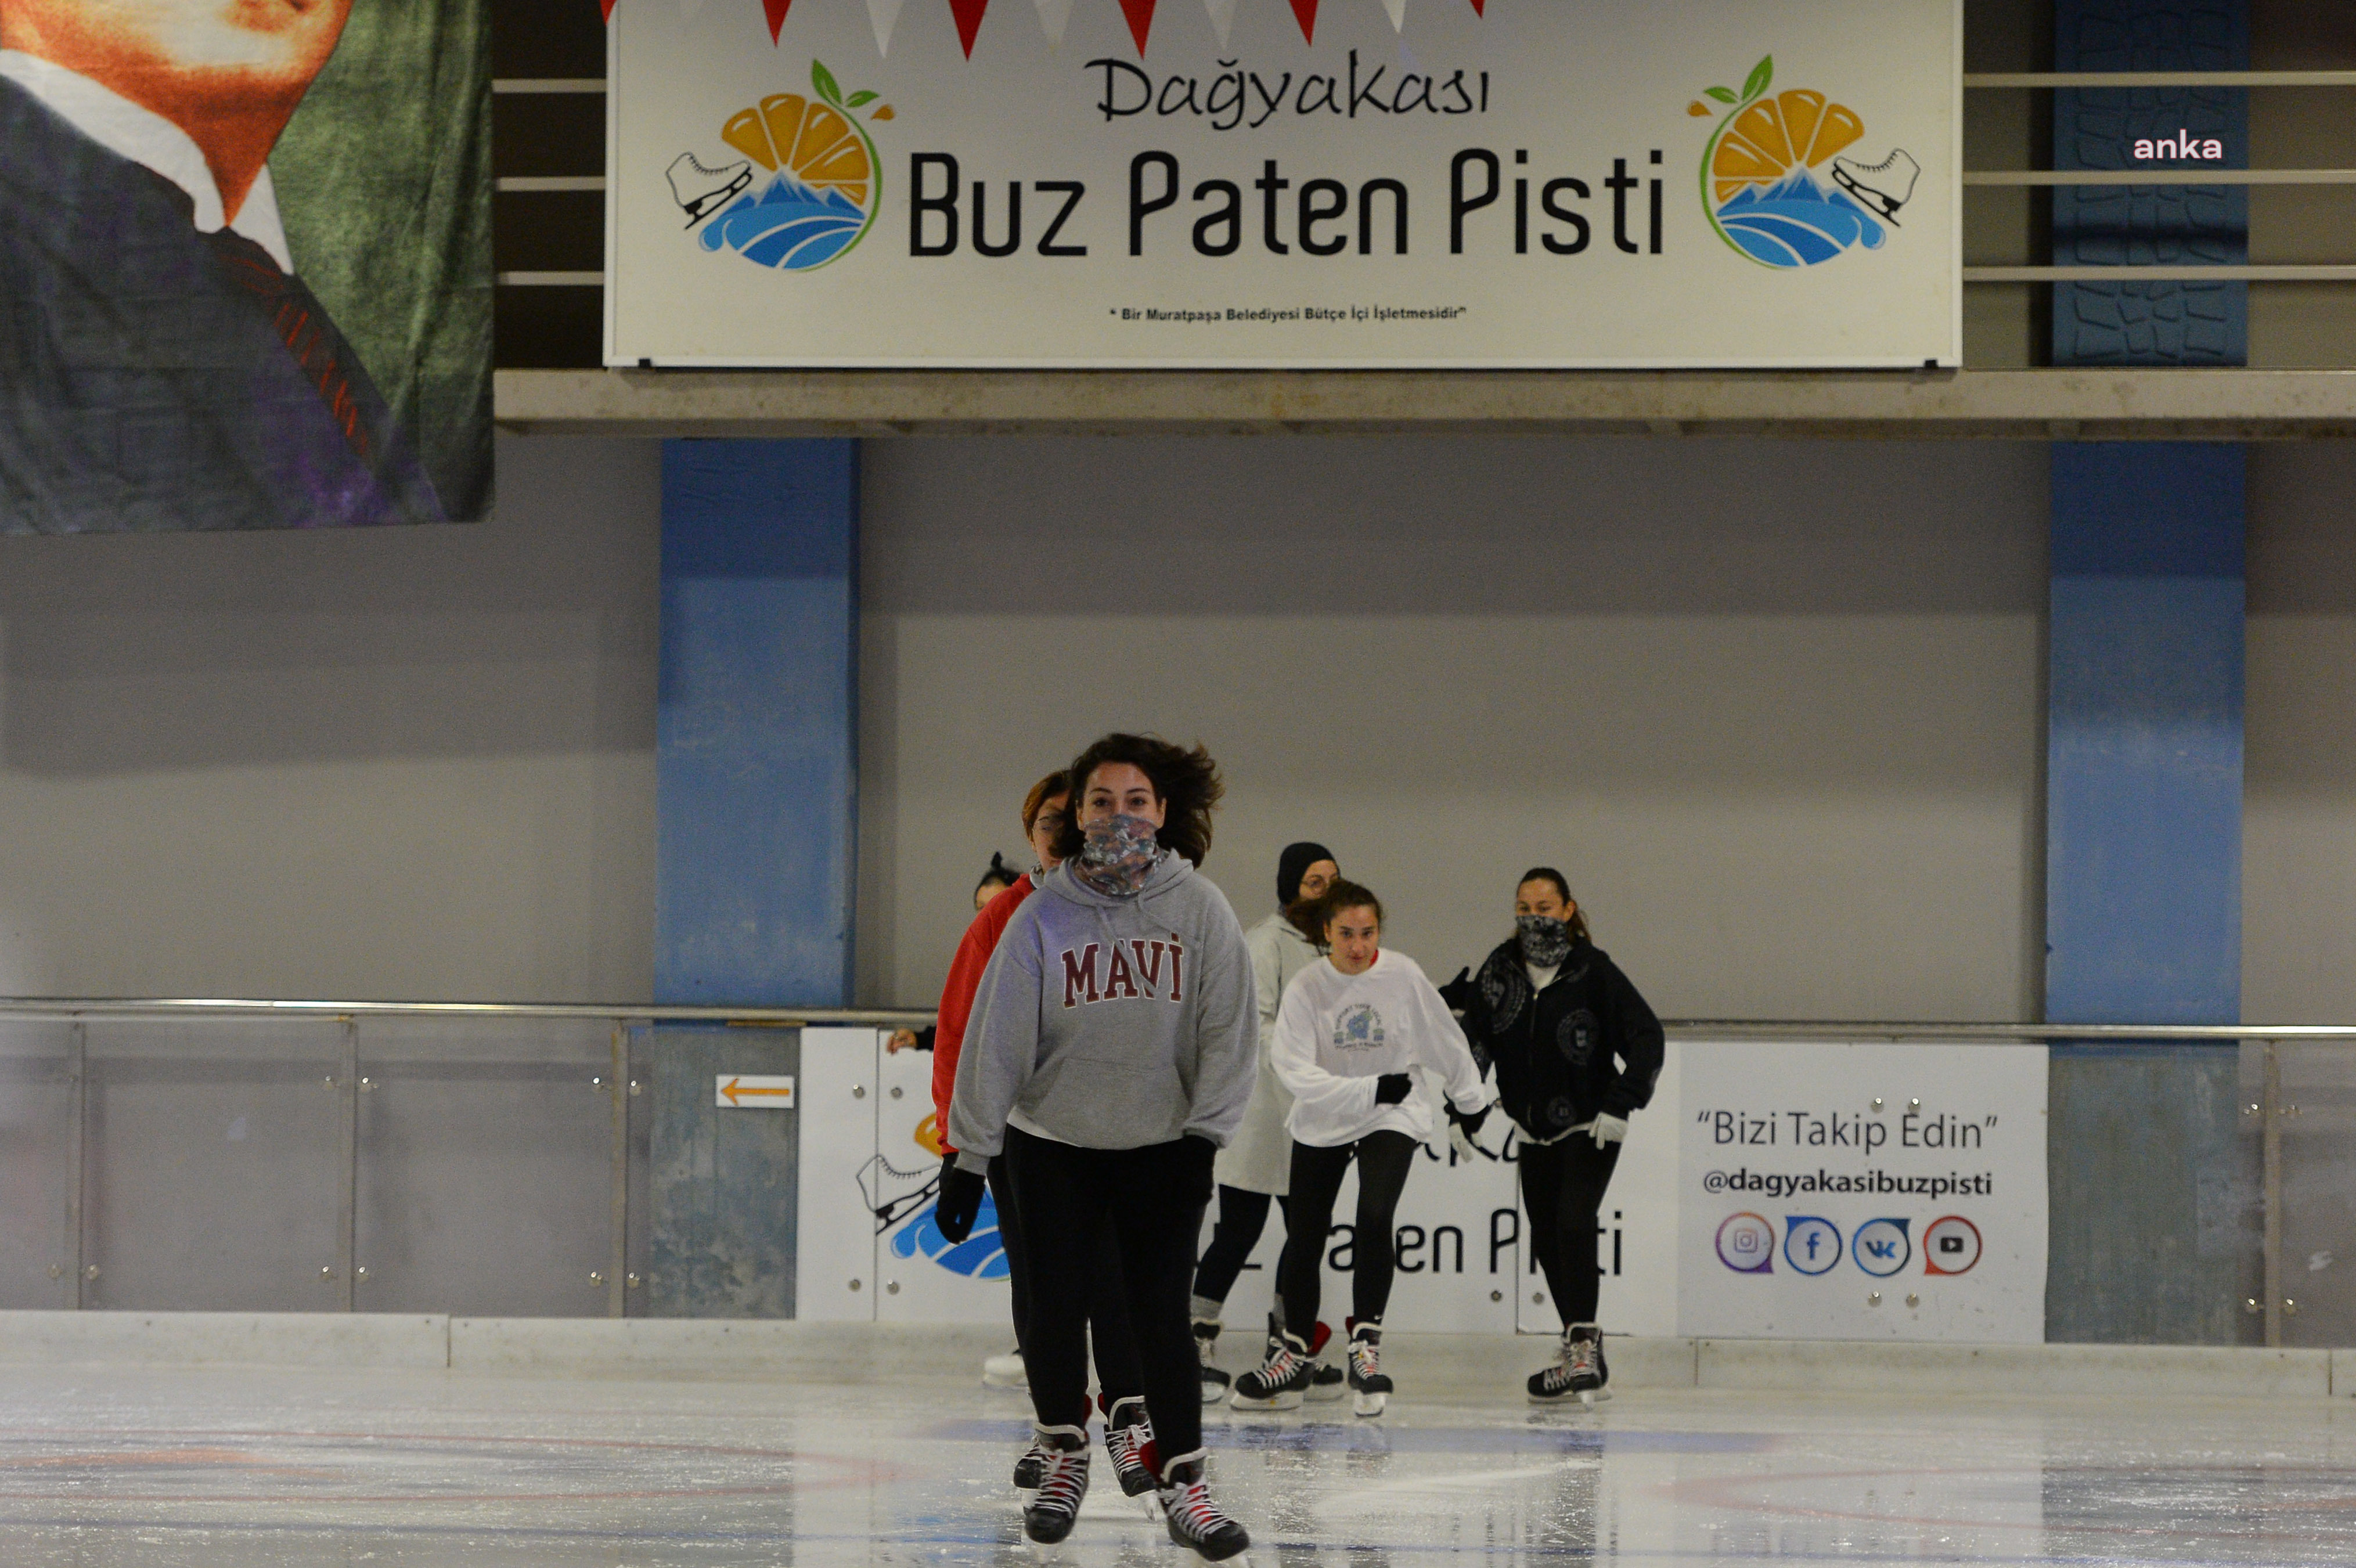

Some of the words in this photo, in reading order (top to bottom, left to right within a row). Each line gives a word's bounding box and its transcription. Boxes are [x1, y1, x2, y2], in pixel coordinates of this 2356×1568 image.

[1084, 48, 1489, 131] Dağyakası
[910, 152, 1087, 258] Buz
[1129, 150, 1408, 257] Paten
[1450, 147, 1662, 255] Pisti
[1122, 308, 1143, 320] Bir
[1147, 308, 1221, 323] Muratpaşa
[1226, 308, 1300, 323] Belediyesi
[1305, 307, 1347, 322] Bütçe
[1698, 1111, 1776, 1144] “Bizi
[1787, 1112, 1887, 1156] Takip
[1703, 1167, 1992, 1200] @dagyakasibuzpisti
[1327, 1224, 1463, 1273] aen
